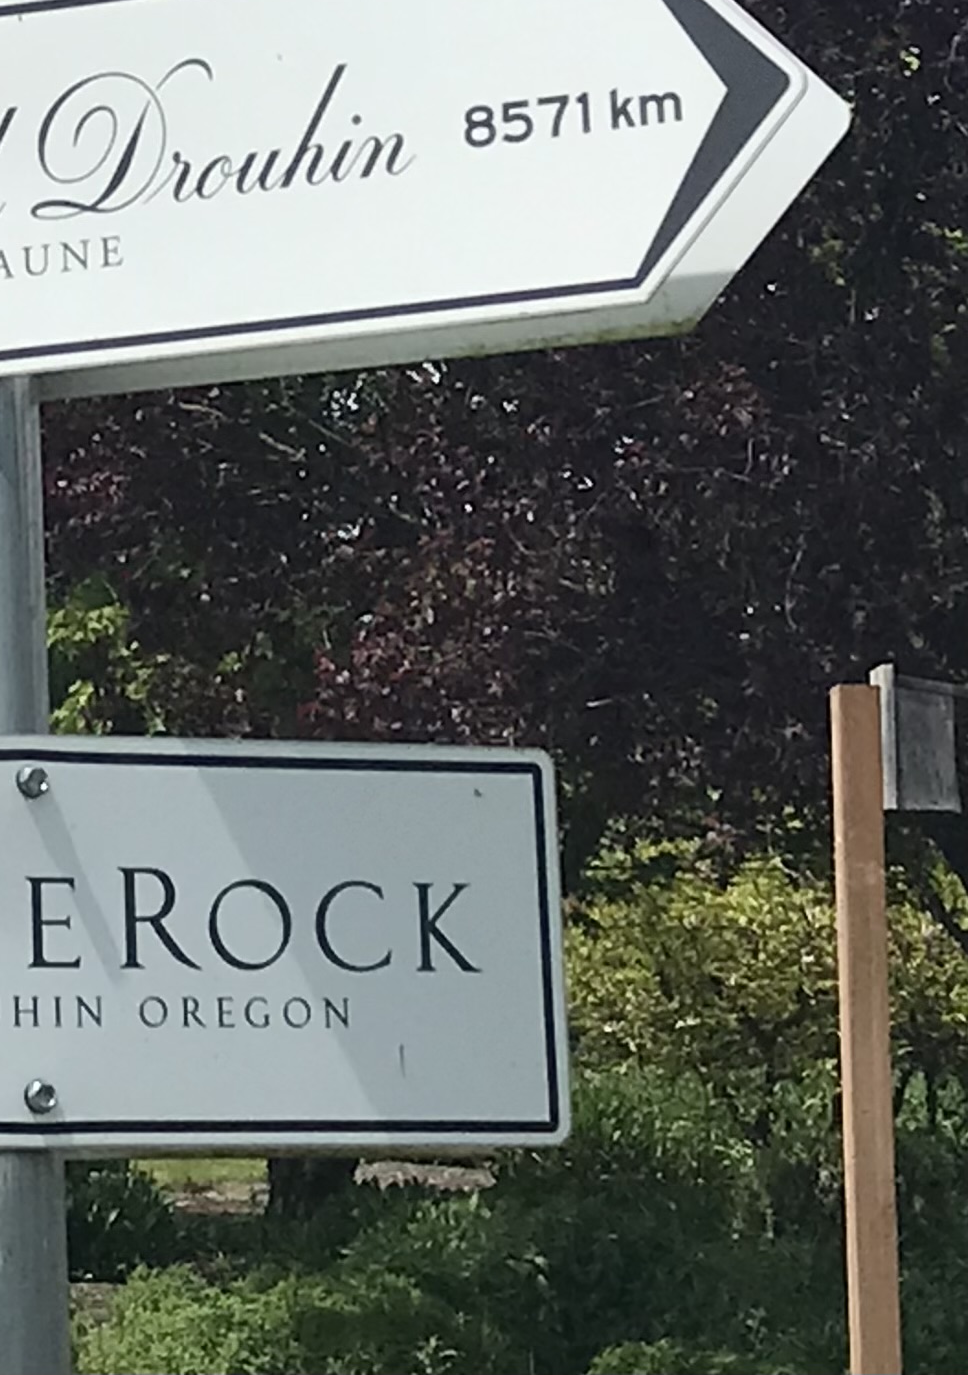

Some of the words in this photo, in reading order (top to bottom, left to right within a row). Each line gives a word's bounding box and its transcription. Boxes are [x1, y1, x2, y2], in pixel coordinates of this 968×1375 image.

[32, 59, 415, 220] Drouhin
[464, 92, 592, 148] 8571
[609, 88, 683, 130] km
[139, 995, 350, 1030] OREGON
